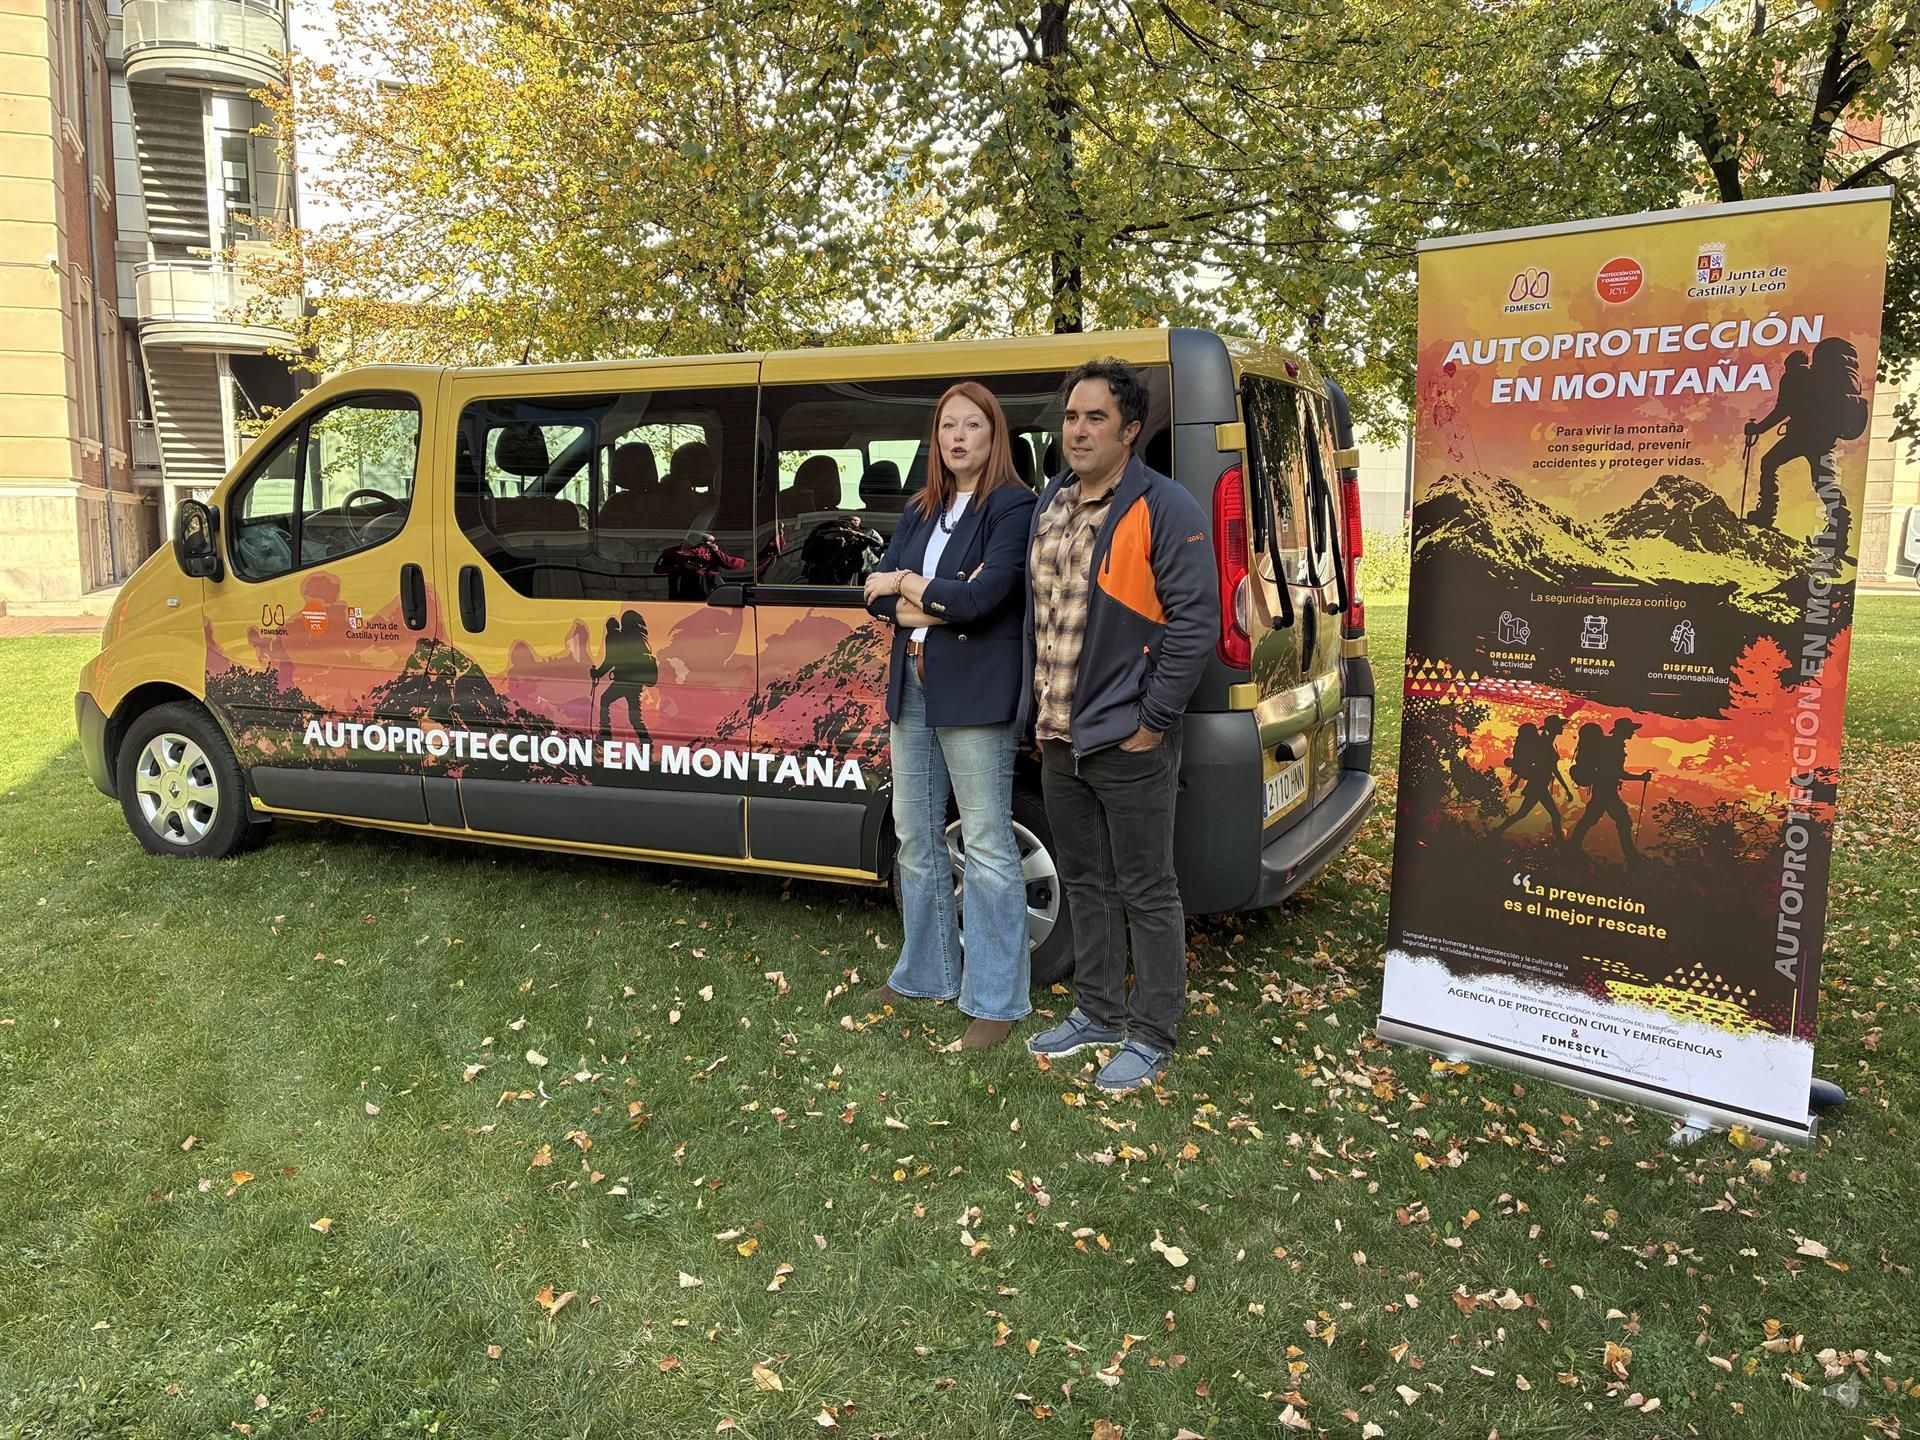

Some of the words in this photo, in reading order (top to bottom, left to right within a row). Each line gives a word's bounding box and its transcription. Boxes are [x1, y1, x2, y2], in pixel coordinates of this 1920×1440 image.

[1726, 269, 1765, 281] Junta
[1769, 266, 1787, 277] de
[1609, 287, 1629, 296] JCYL
[1687, 284, 1735, 298] Castilla
[1738, 285, 1747, 297] y
[1752, 280, 1786, 293] León
[1504, 302, 1552, 313] FDMESCYL
[1442, 312, 1825, 367] AUTOPROTECCIÓN
[1491, 375, 1543, 403] EN
[1551, 358, 1773, 401] MONTAÑA
[1585, 424, 1611, 436] vivir
[1614, 424, 1624, 435] la
[1628, 422, 1684, 435] montaña
[1548, 443, 1569, 453] con
[1572, 440, 1634, 454] seguridad,
[1638, 438, 1691, 453] prevenir
[1532, 457, 1597, 469] accidentes
[1600, 460, 1607, 469] y
[1609, 456, 1665, 469] proteger
[1667, 455, 1705, 467] vidas.
[1530, 591, 1543, 602] La
[1545, 593, 1595, 606] seguridad
[1596, 596, 1642, 608] empieza
[1644, 597, 1687, 609] contigo
[366, 621, 390, 630] Junta
[391, 622, 399, 630] de
[346, 630, 373, 640] Castilla
[374, 633, 380, 641] y
[380, 632, 400, 641] León
[1489, 651, 1537, 662] ORGANIZA
[1570, 656, 1616, 668] PREPARA
[1500, 660, 1533, 670] actividad
[1575, 665, 1582, 673] el
[1583, 667, 1610, 677] equipo
[1663, 663, 1715, 674] DISFRUTA
[1647, 671, 1663, 679] con
[1664, 672, 1729, 685] responsabilidad
[302, 719, 593, 768] AUTOPROTECCIÓN
[603, 740, 651, 772] EN
[661, 745, 867, 791] MONTAÑA
[1268, 774, 1290, 811] 2110
[1774, 686, 1823, 983] AUTOPROTECCIÓN
[1801, 633, 1827, 678] EN
[1549, 886, 1646, 915] prevención
[1503, 899, 1523, 912] es
[1527, 902, 1541, 916] el
[1545, 906, 1594, 926] mejor
[1598, 916, 1668, 940] rescate
[1402, 930, 1428, 941] Campaña
[1429, 936, 1442, 944] para
[1442, 938, 1468, 950] fomentar
[1475, 945, 1520, 960] autoprotección
[1532, 956, 1553, 967] cultura
[1553, 961, 1562, 969] de
[1563, 963, 1569, 971] la
[1402, 939, 1429, 949] seguridad
[1439, 945, 1472, 958] actividades
[1480, 954, 1507, 965] montaña
[1512, 960, 1521, 968] del
[1522, 963, 1541, 973] medio
[1447, 987, 1495, 1006] AGENCIA
[1498, 998, 1513, 1010] DE
[1516, 1002, 1588, 1027] PROTECCIÓN
[1590, 1020, 1620, 1035] CIVIL
[1623, 1027, 1631, 1037] Y
[1633, 1030, 1723, 1059] EMERGENCIAS
[1571, 1028, 1579, 1038] &
[1542, 1034, 1609, 1059] FDMESCYL
